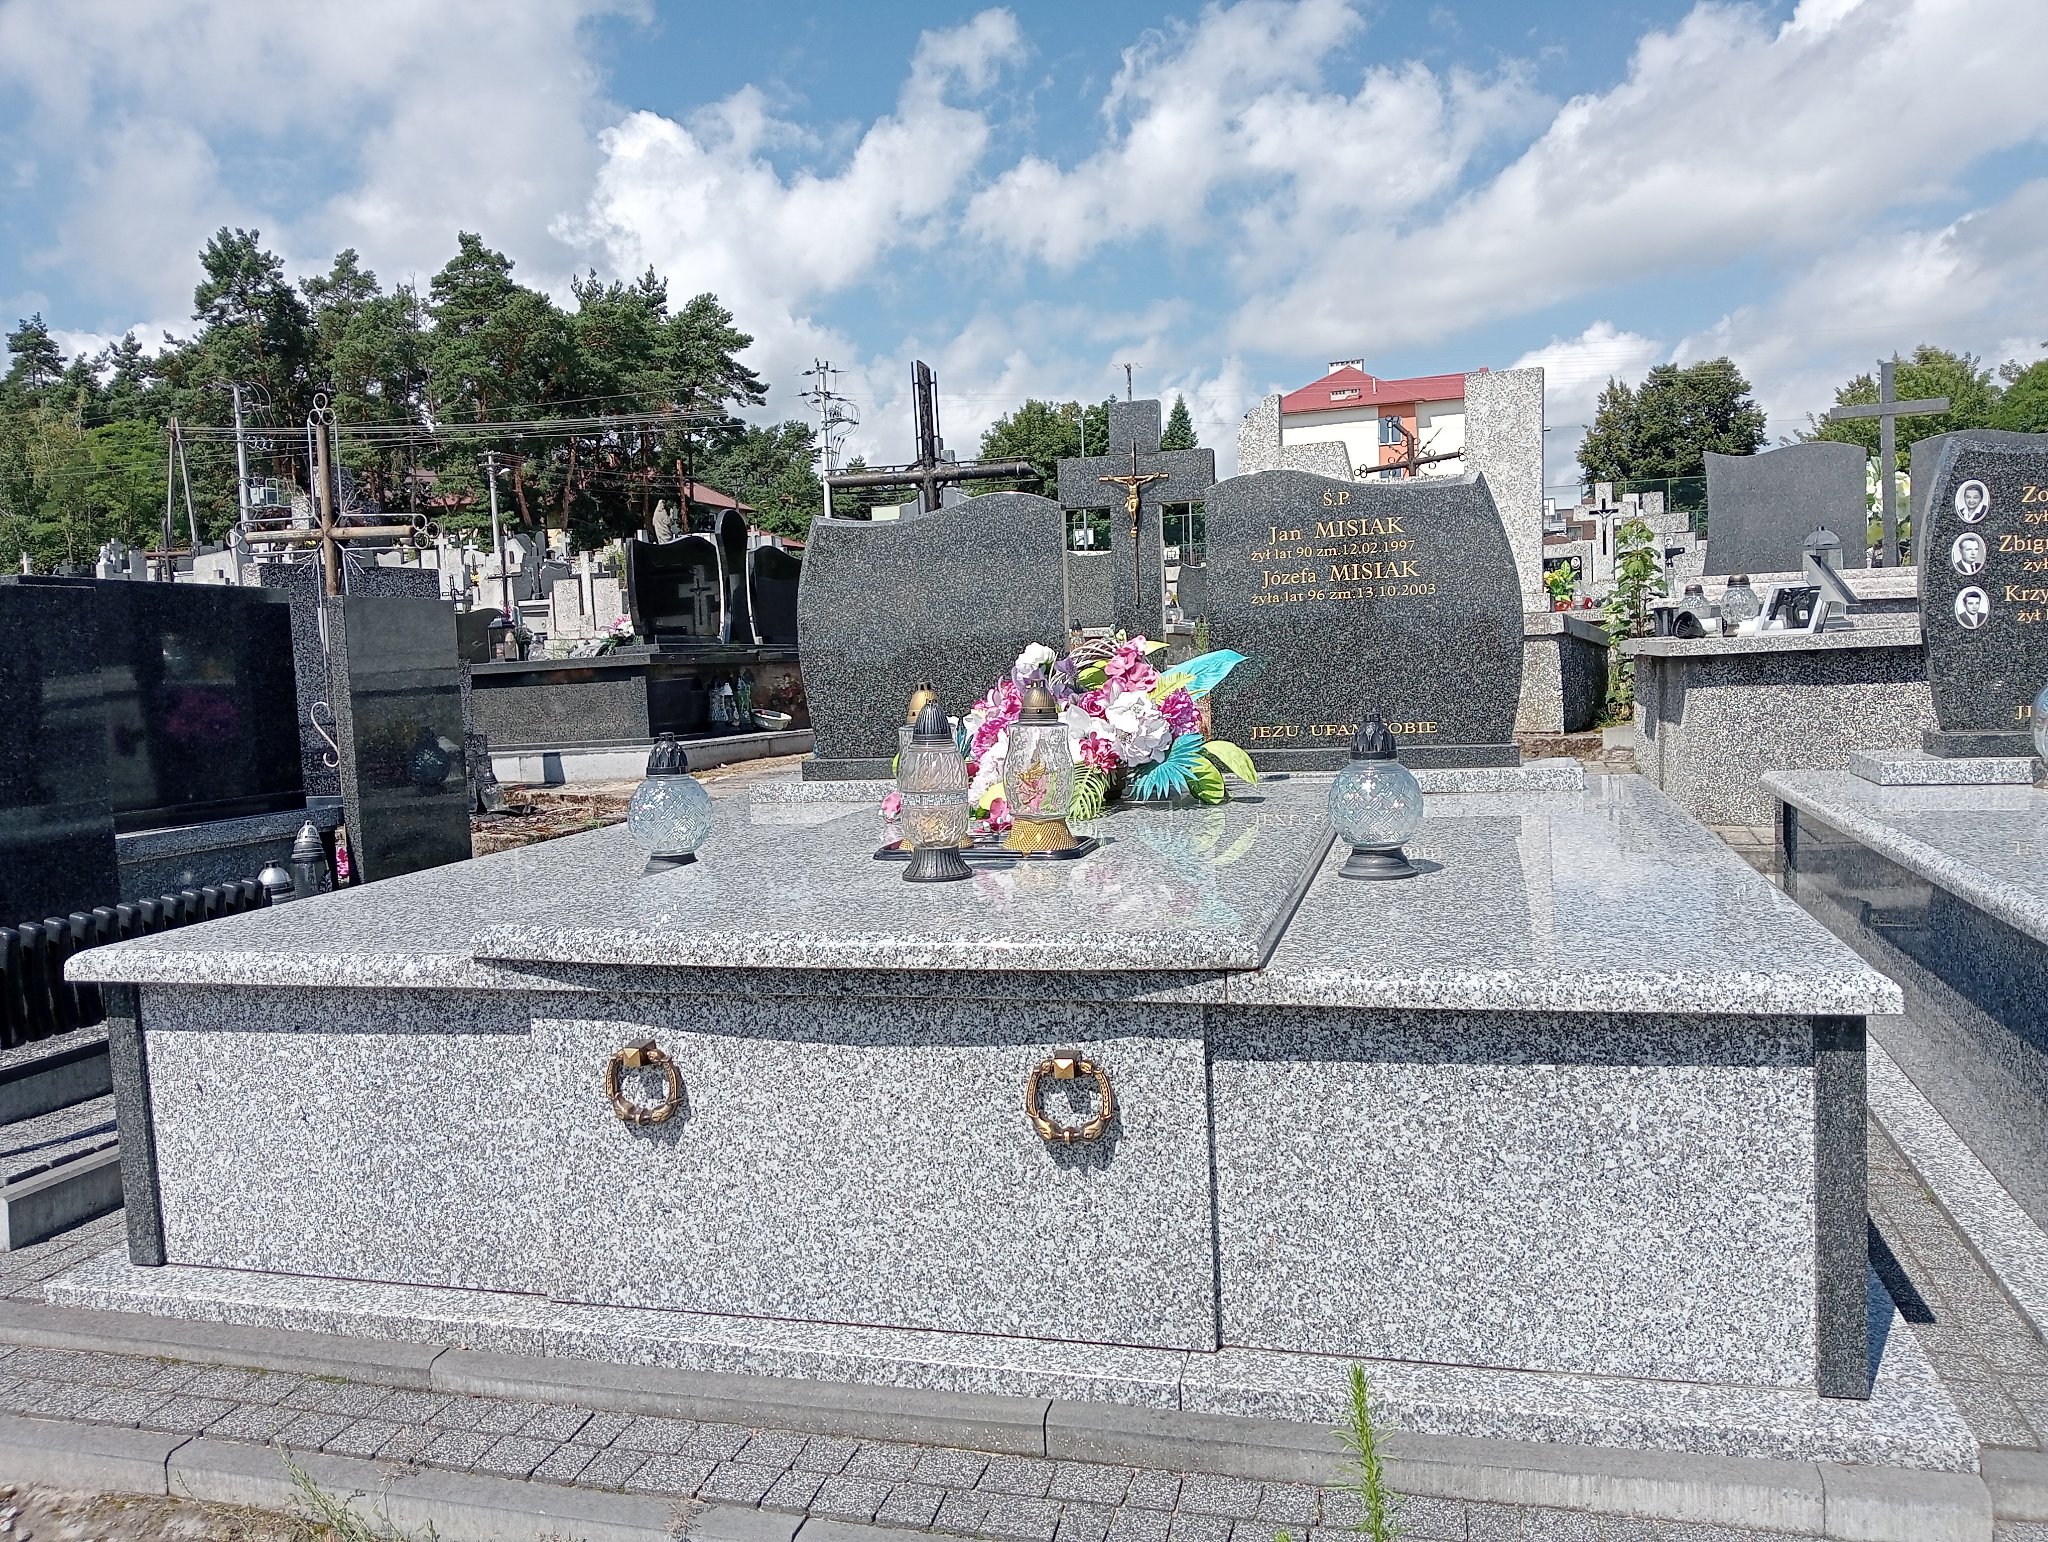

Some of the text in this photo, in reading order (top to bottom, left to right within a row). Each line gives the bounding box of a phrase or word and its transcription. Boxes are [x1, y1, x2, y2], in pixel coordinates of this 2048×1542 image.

[1323, 488, 1351, 507] Ś.P.
[1268, 516, 1405, 545] Jan MISIAK
[1251, 548, 1271, 563] żył
[1274, 548, 1292, 560] lat
[1296, 546, 1313, 558] 90
[1262, 560, 1421, 589] Józefa MISIAK
[1251, 592, 1280, 606] żyła
[1284, 591, 1304, 602] lat
[1308, 589, 1325, 601] 96
[2016, 609, 2041, 624] żył
[1250, 725, 1300, 740] JEZU
[1384, 721, 1438, 735] OBIE
